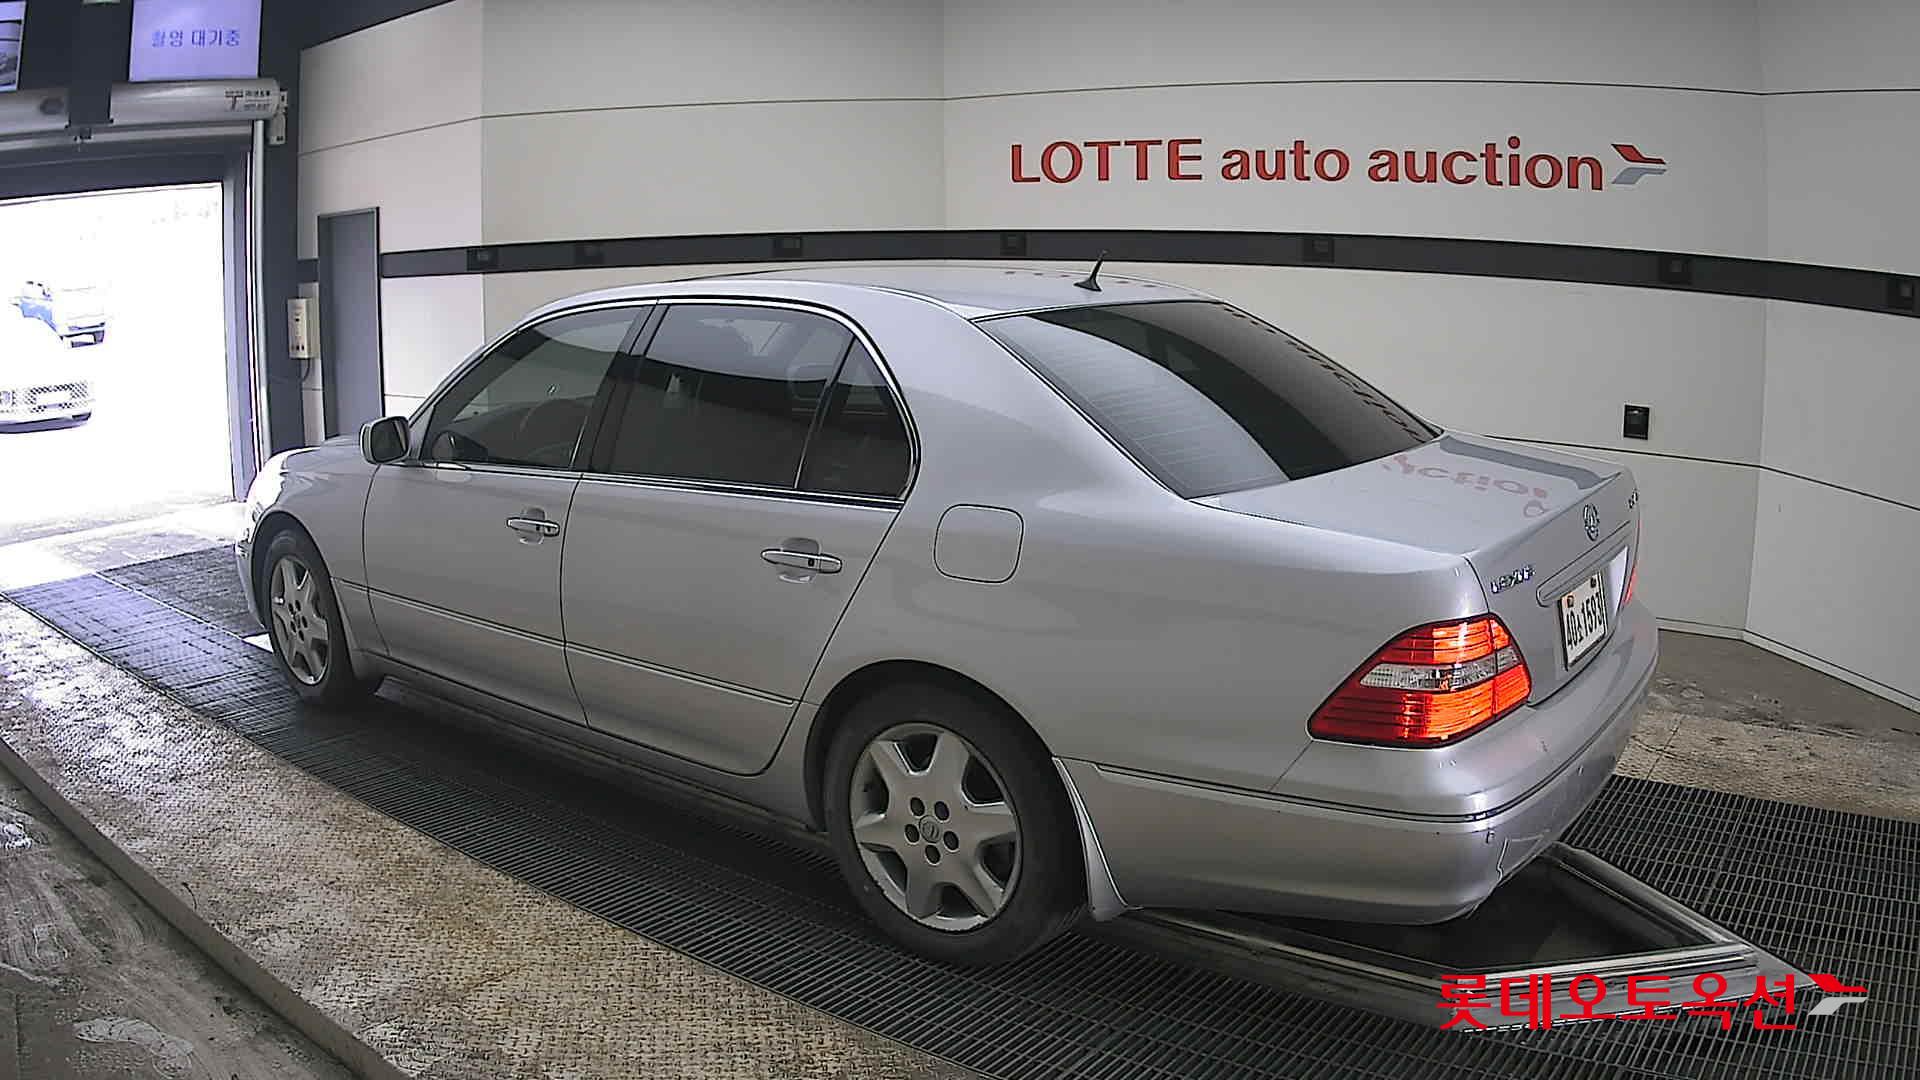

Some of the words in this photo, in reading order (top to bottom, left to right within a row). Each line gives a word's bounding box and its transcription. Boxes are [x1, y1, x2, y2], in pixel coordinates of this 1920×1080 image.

[191, 30, 239, 48] 대기중
[1011, 138, 1203, 183] LOTTE
[1221, 140, 1350, 181] auto
[1367, 136, 1603, 191] auction
